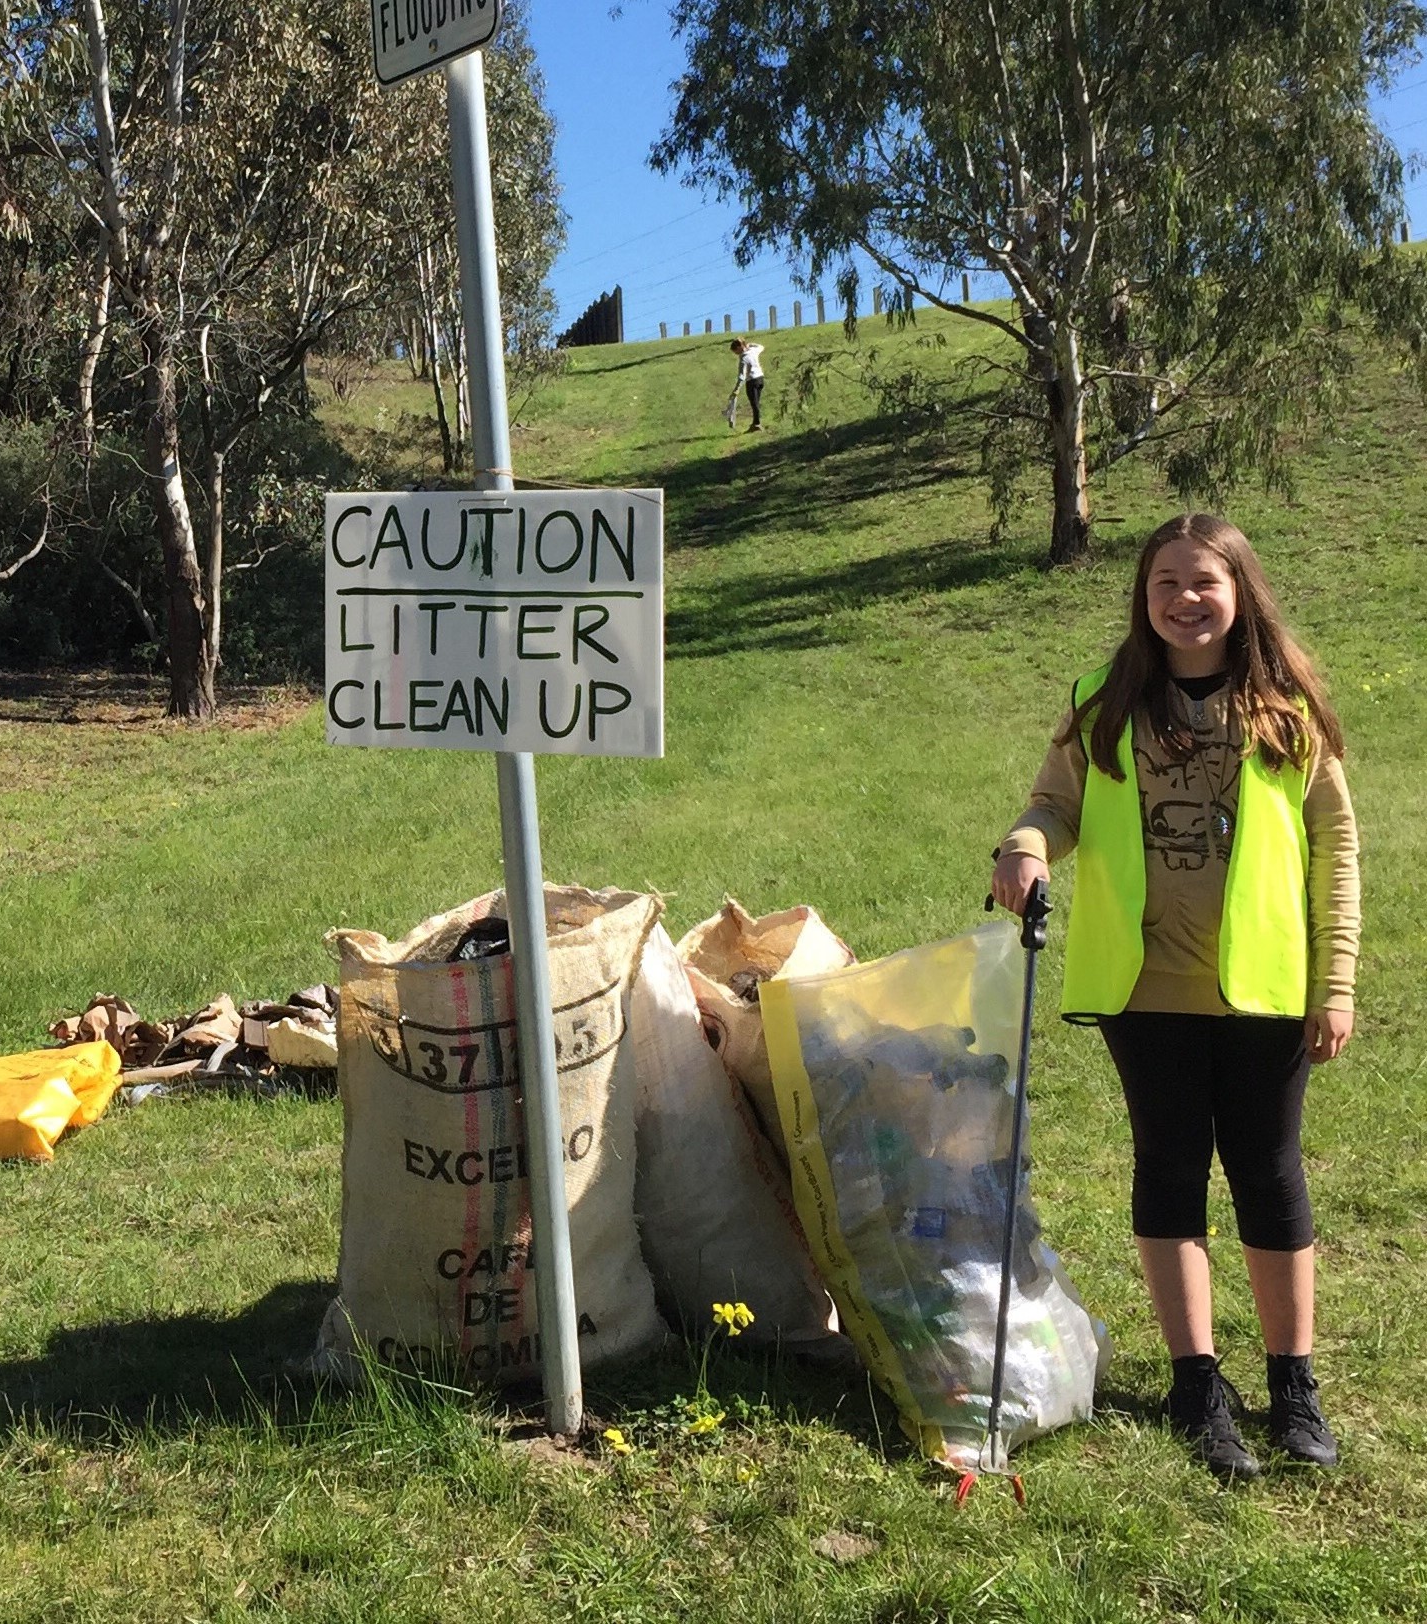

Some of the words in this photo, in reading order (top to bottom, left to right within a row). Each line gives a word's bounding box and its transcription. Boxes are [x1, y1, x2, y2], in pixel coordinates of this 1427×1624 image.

[380, 0, 487, 53] FLOOD
[331, 505, 635, 582] CAUTION
[340, 602, 619, 665] LITTER
[328, 676, 510, 736] CLEAN
[538, 679, 632, 742] UP
[418, 1041, 480, 1084] 37
[403, 1124, 594, 1186] EXCELO
[464, 1288, 521, 1328] DE
